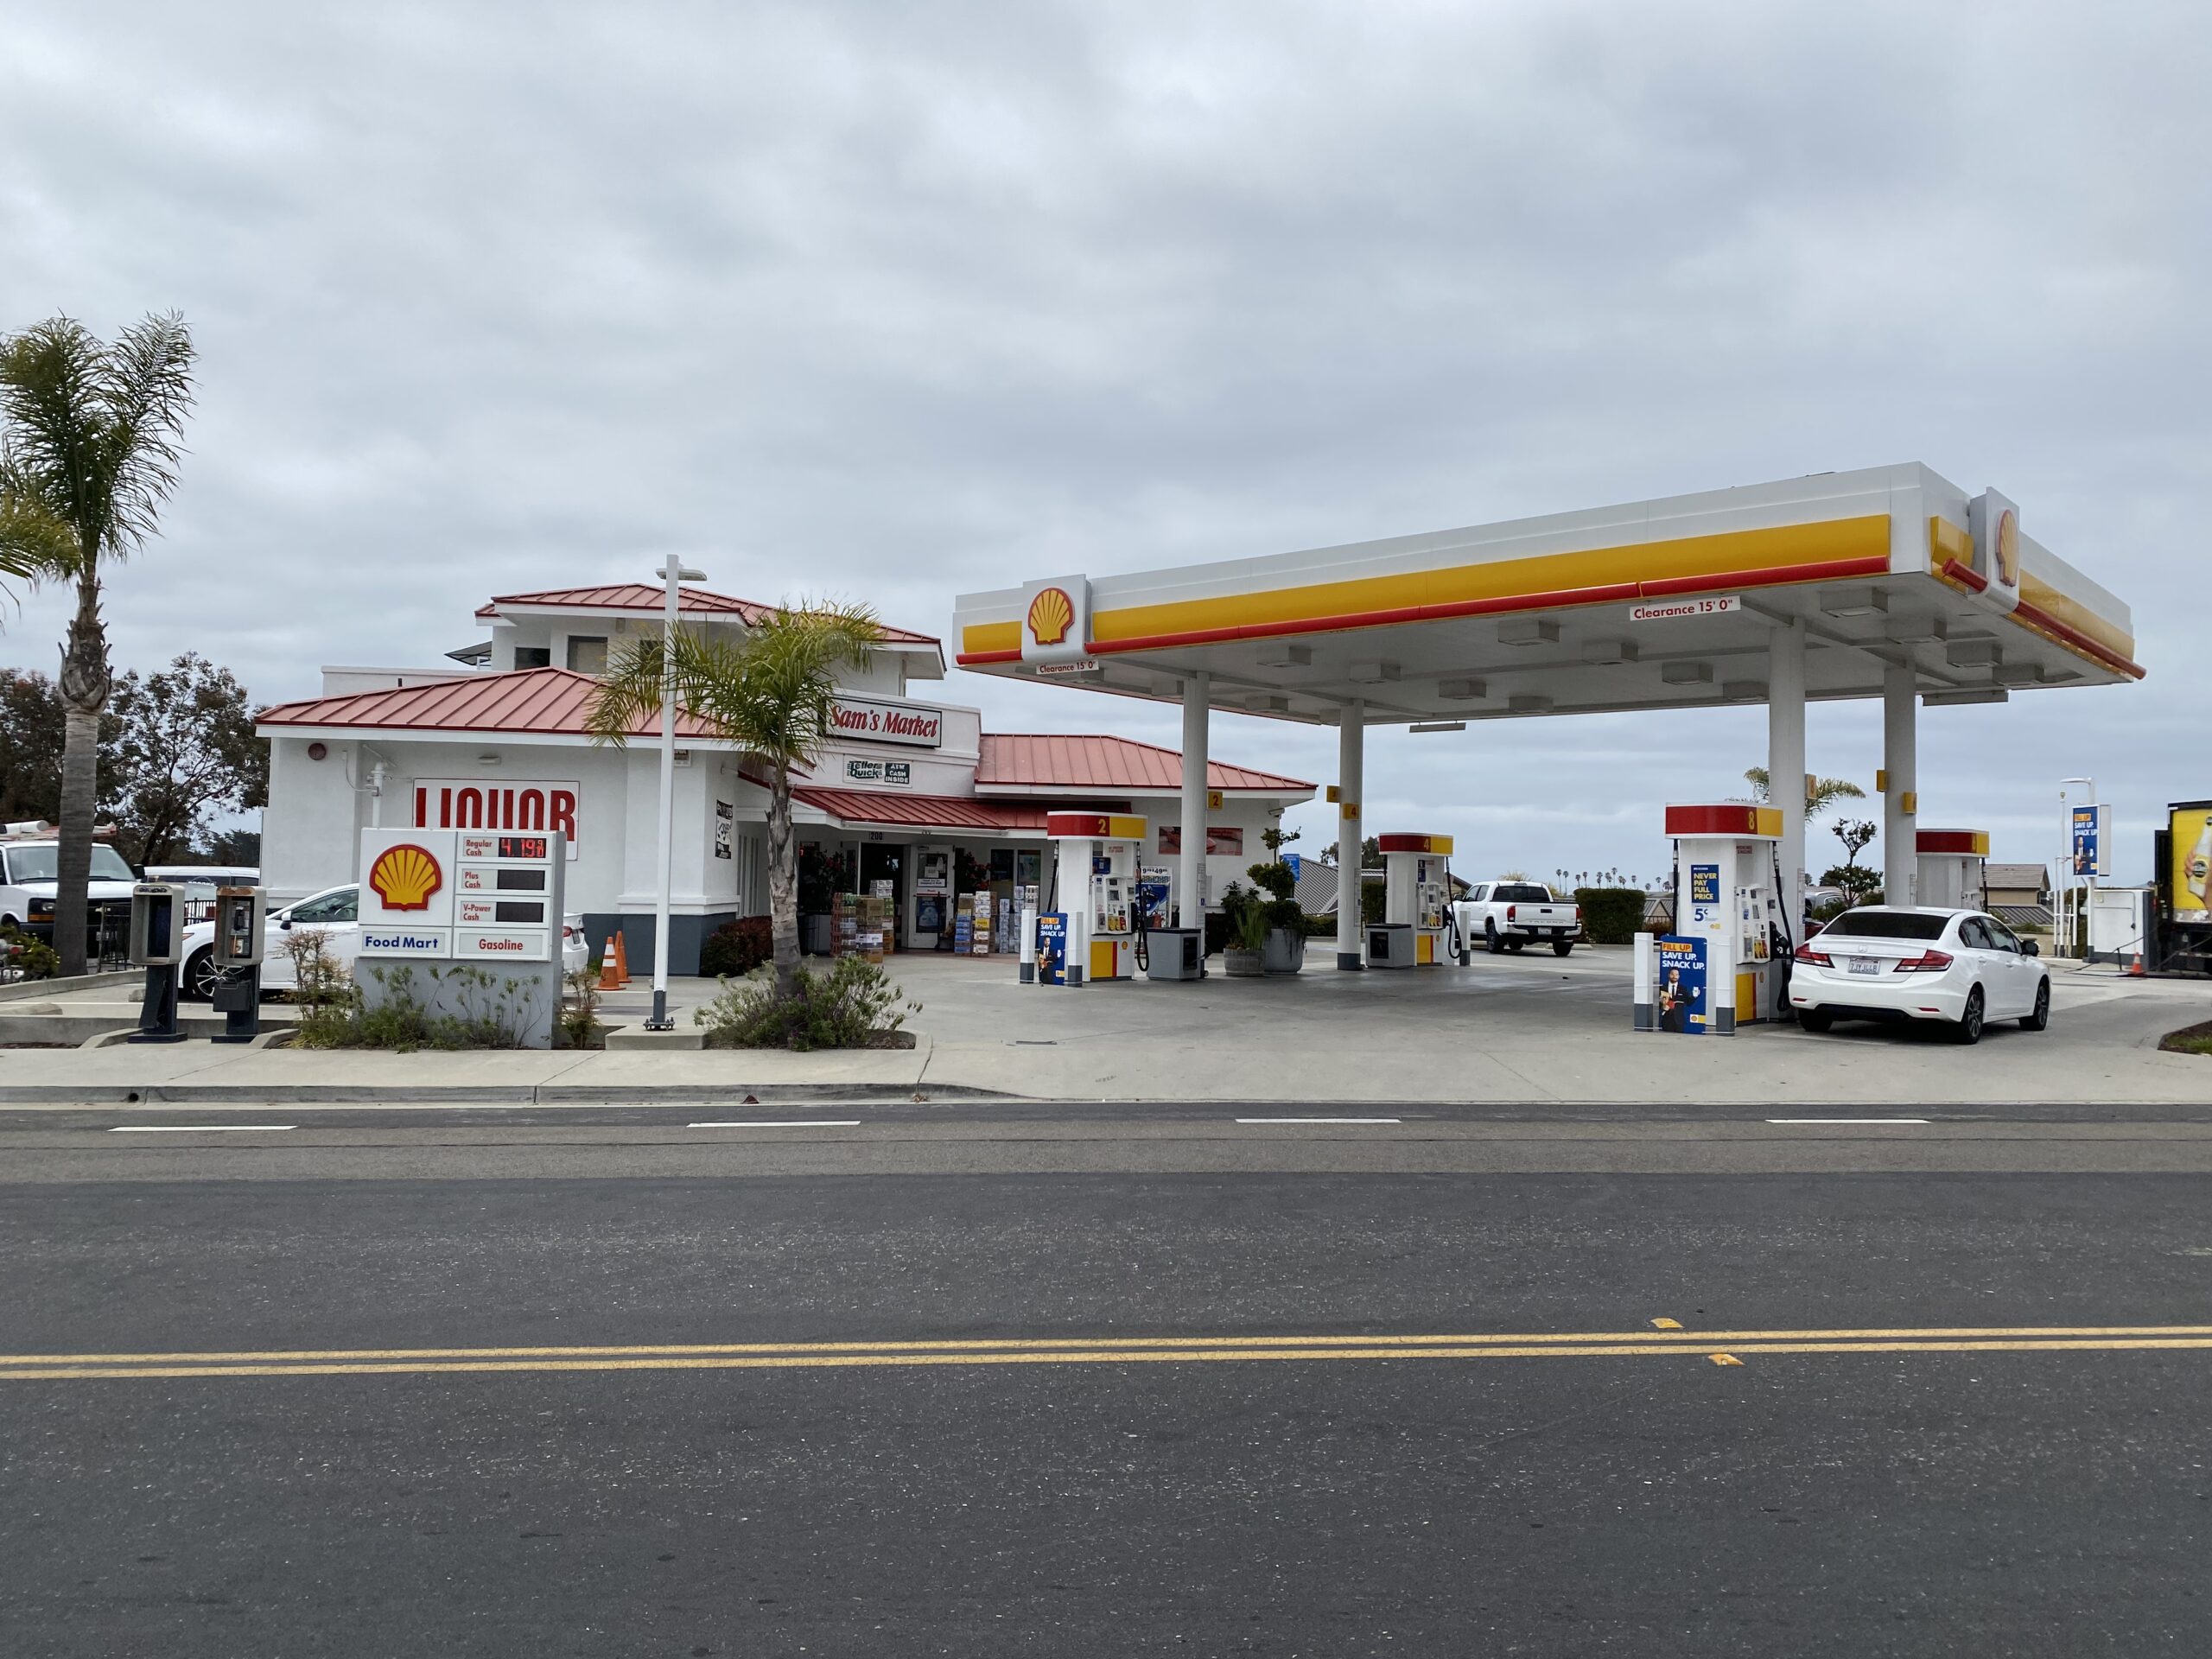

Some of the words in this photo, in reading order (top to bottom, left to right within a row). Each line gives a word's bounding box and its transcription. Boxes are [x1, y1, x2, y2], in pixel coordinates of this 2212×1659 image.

[1634, 606, 1694, 619] Clearance
[1699, 601, 1715, 612] 15'
[1719, 599, 1732, 610] 0"
[1039, 664, 1074, 673] Clearance
[830, 705, 880, 731] Sam's
[882, 711, 938, 737] Market
[849, 760, 880, 770] Teller
[849, 769, 879, 779] Quick
[1212, 795, 1219, 806] 2
[1748, 810, 1755, 830] 8
[1098, 818, 1106, 834] 2
[466, 839, 493, 848] Regular
[1423, 838, 1430, 850] 4
[463, 904, 491, 912] V-Power
[463, 912, 480, 921] Cash
[365, 936, 400, 948] Food
[403, 937, 438, 949] Mart
[479, 938, 524, 950] Gasoline
[1662, 951, 1682, 960] SAVE
[1662, 959, 1691, 969] SNACK
